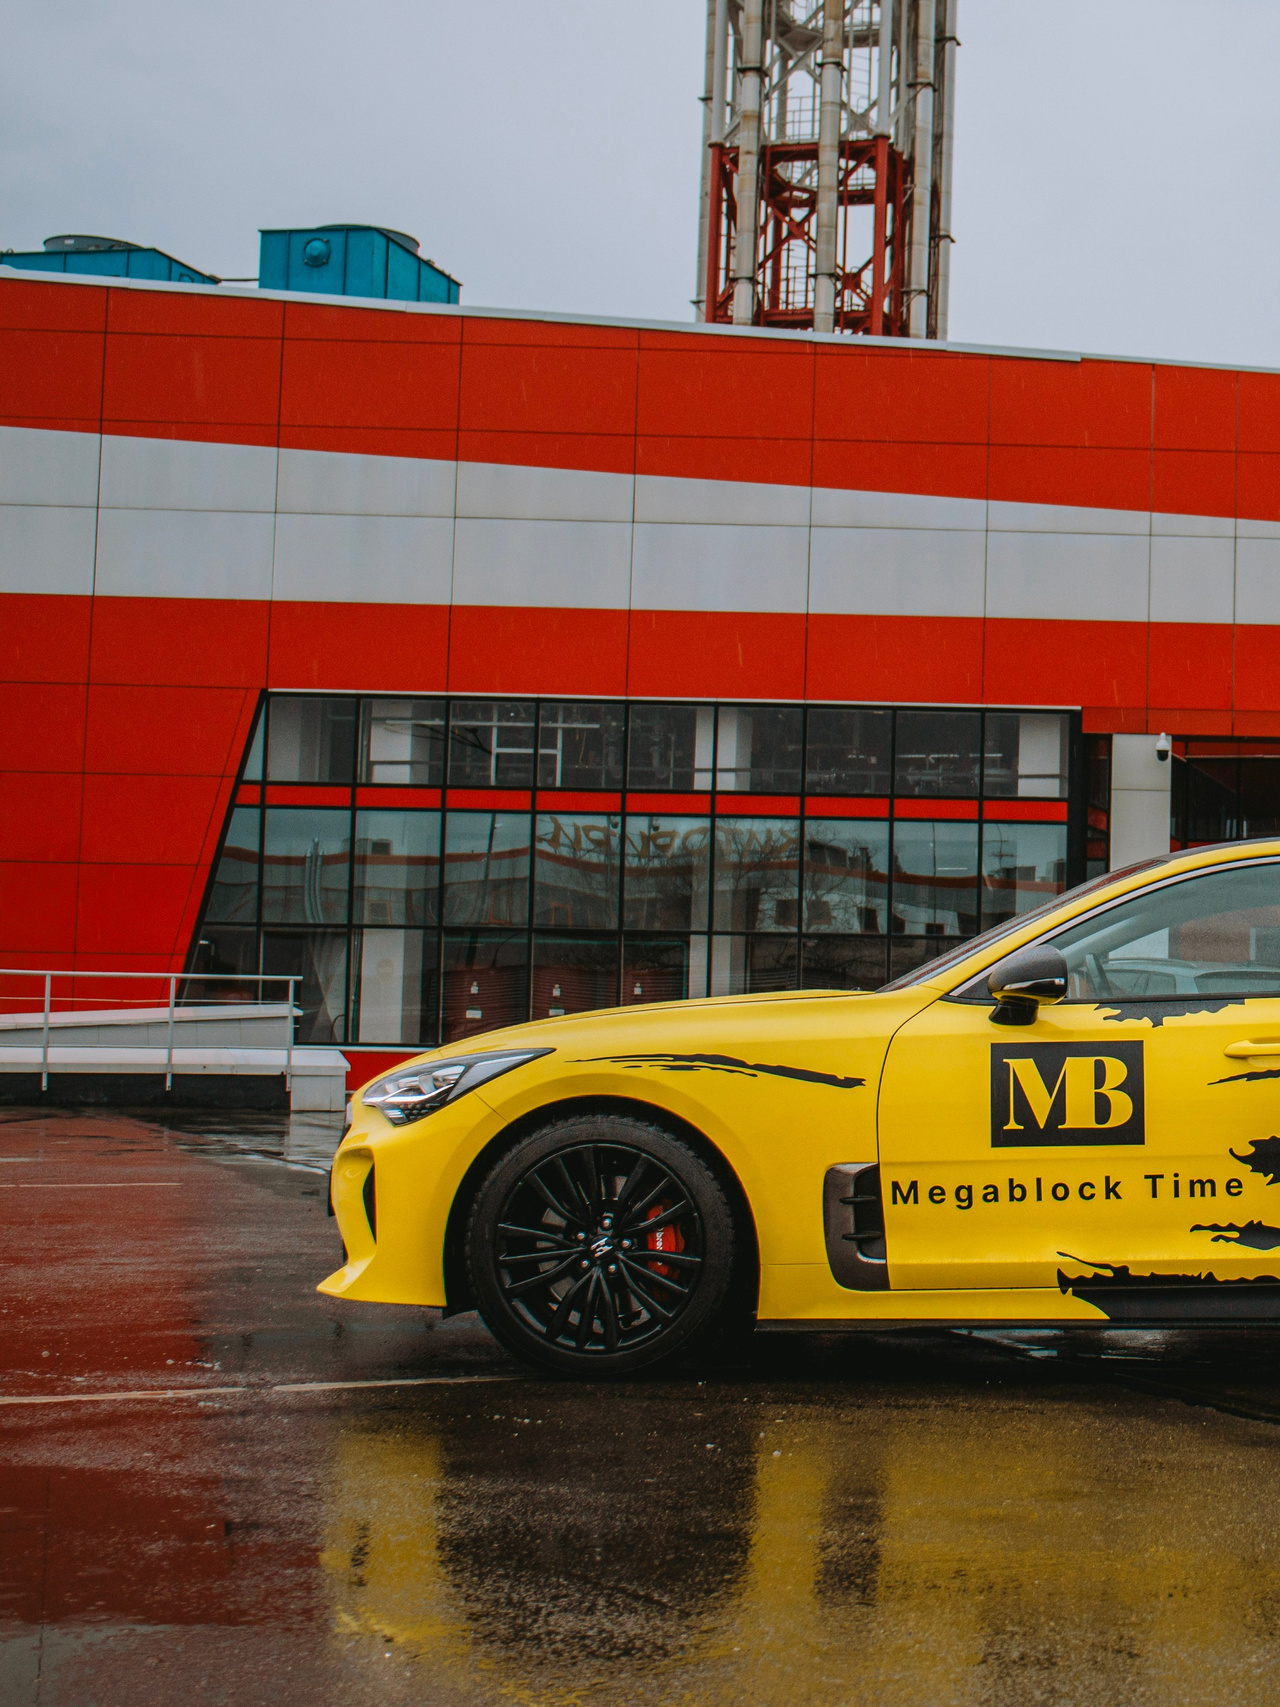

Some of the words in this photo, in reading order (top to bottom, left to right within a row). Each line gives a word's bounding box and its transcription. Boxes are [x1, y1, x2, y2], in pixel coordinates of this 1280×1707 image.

[1002, 1056, 1134, 1130] MB
[891, 1175, 1122, 1210] Megablock
[1144, 1172, 1244, 1200] Time
